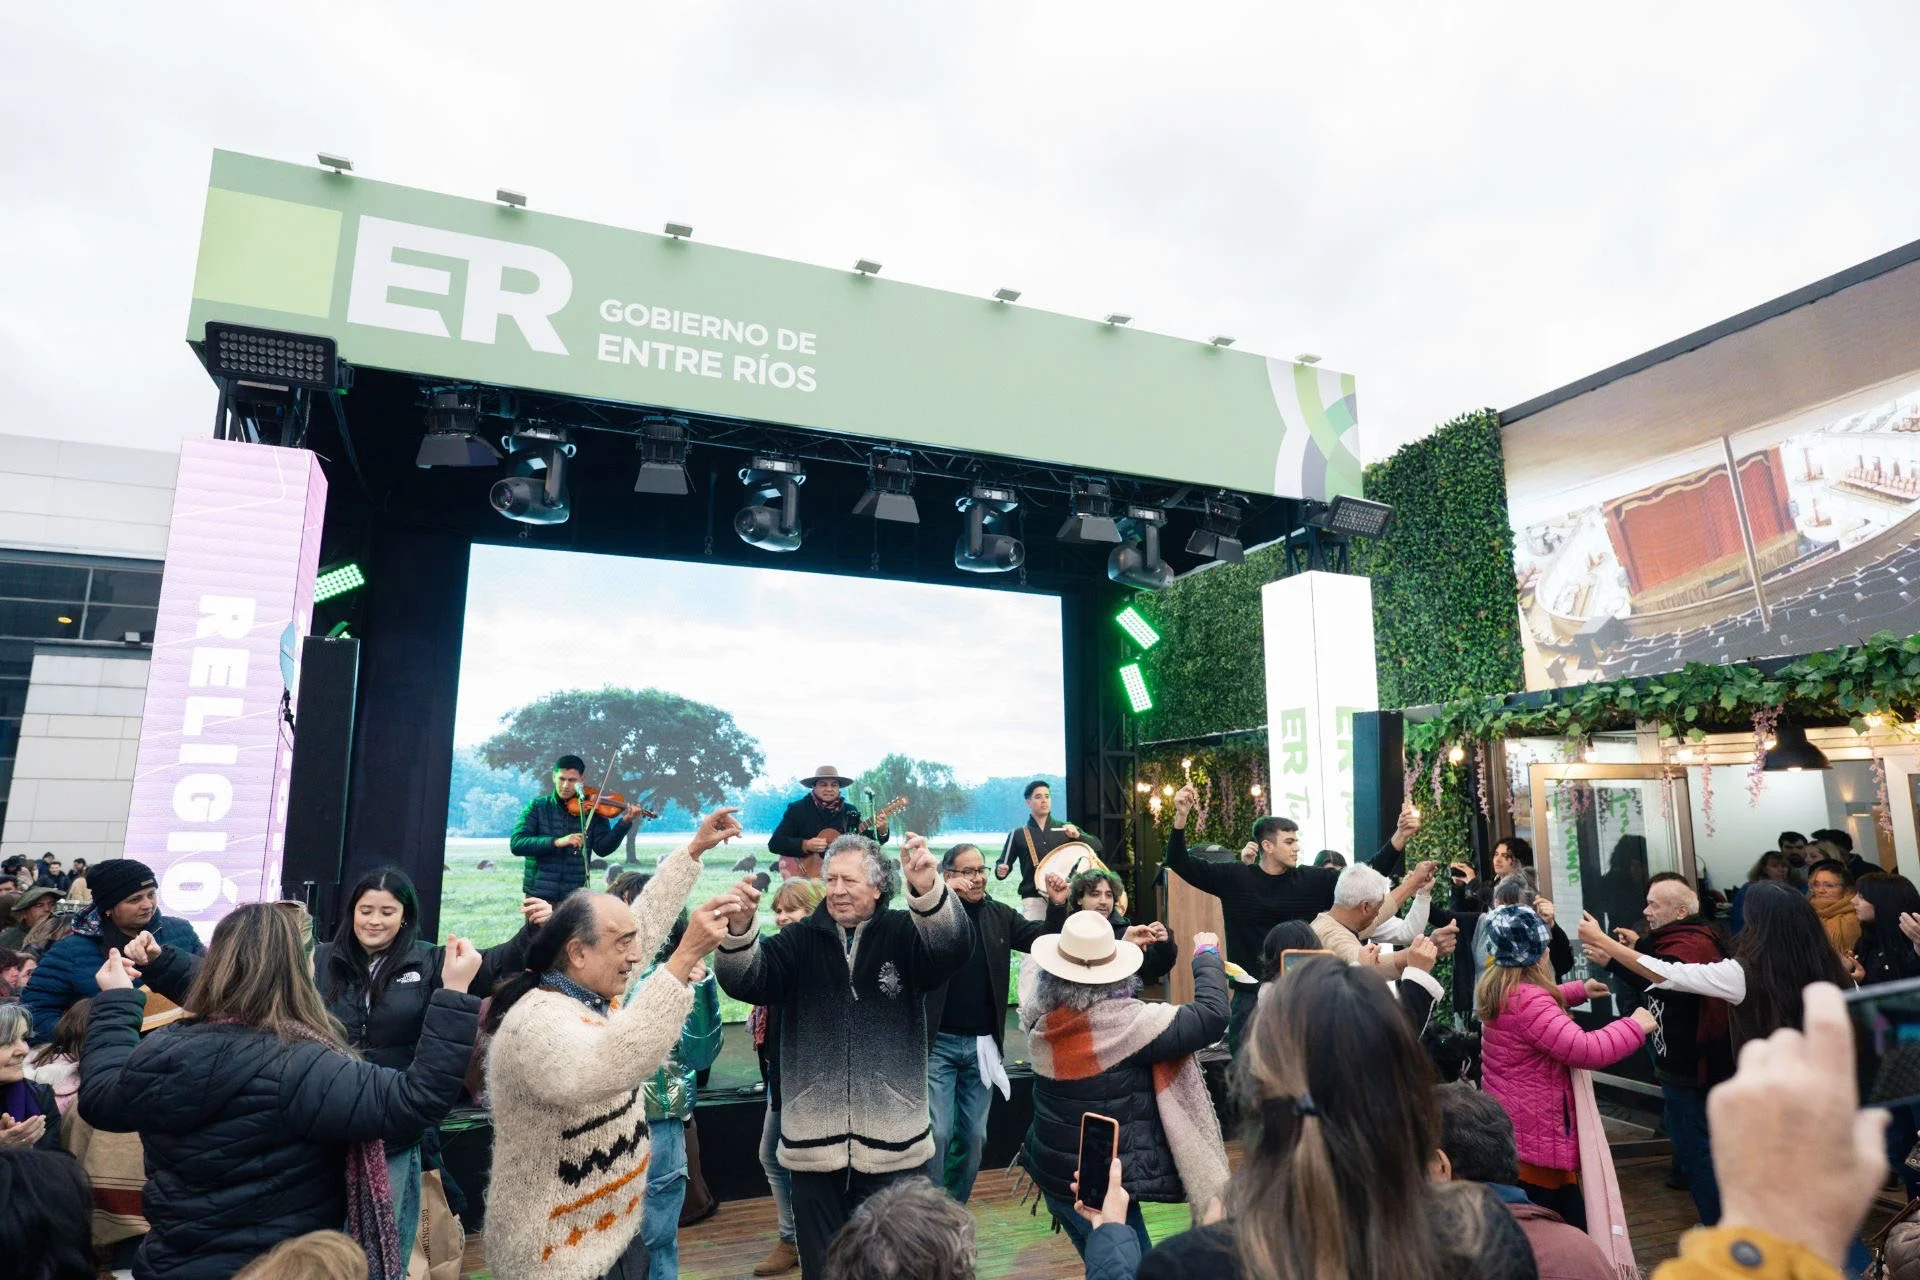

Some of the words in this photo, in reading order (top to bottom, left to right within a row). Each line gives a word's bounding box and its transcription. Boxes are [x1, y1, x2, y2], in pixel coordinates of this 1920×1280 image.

[347, 214, 573, 356] ER
[599, 299, 769, 347] GOBIERNO
[777, 328, 817, 355] DE
[597, 333, 724, 379] ENTRE
[733, 353, 818, 393] RÍOS
[160, 594, 257, 946] RELIGIÓ
[1280, 707, 1309, 776] ER
